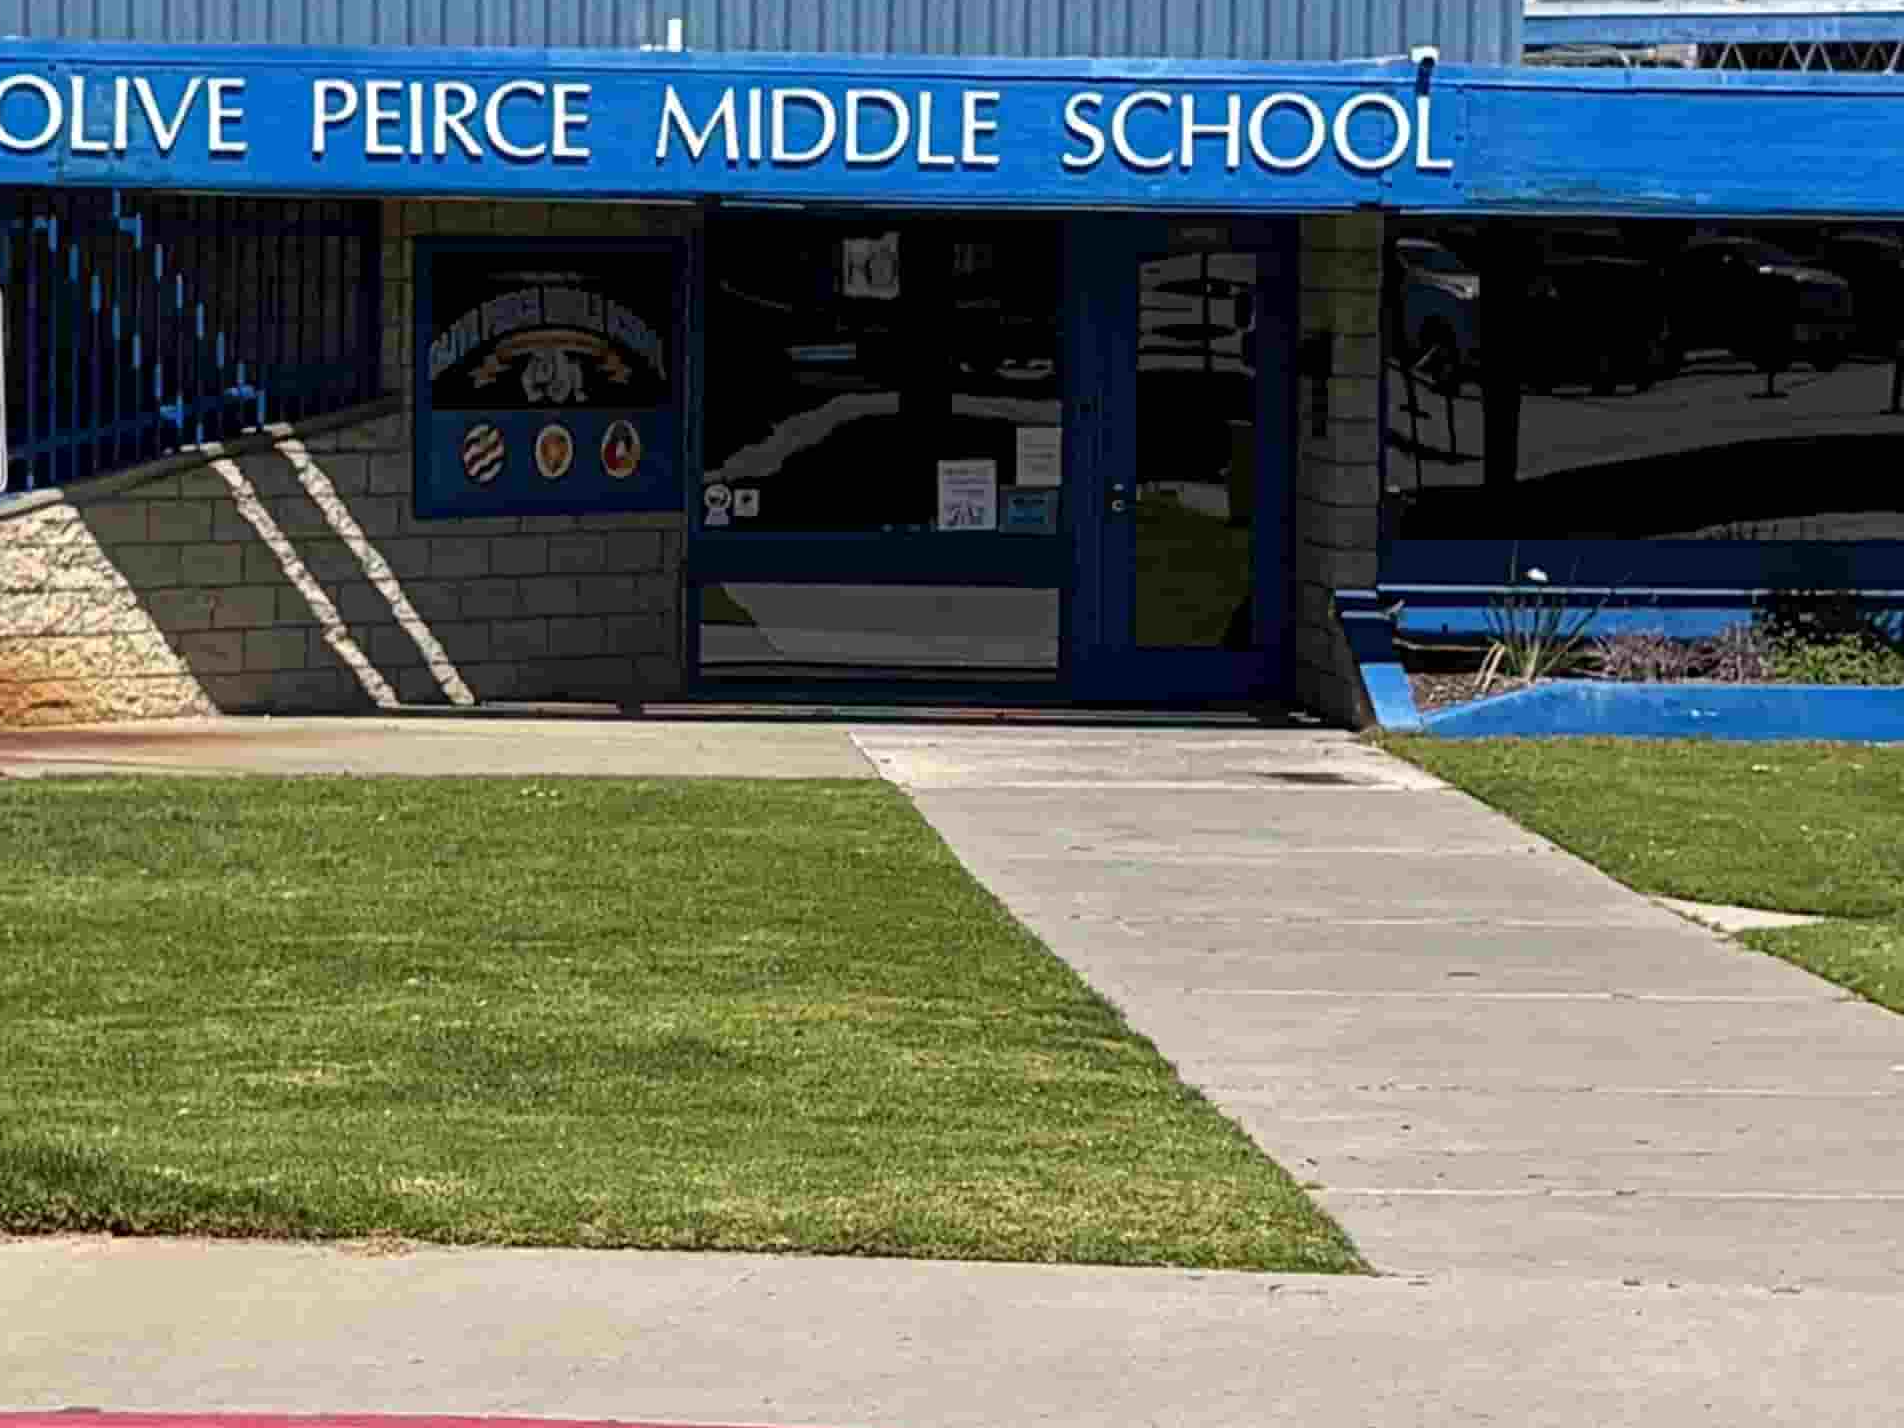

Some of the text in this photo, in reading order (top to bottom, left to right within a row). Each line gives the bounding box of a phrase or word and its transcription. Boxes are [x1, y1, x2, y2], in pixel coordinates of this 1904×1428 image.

[311, 79, 593, 158] PEIRCE
[655, 85, 1002, 166] MIDDLE
[1062, 90, 1455, 170] SCHOOL
